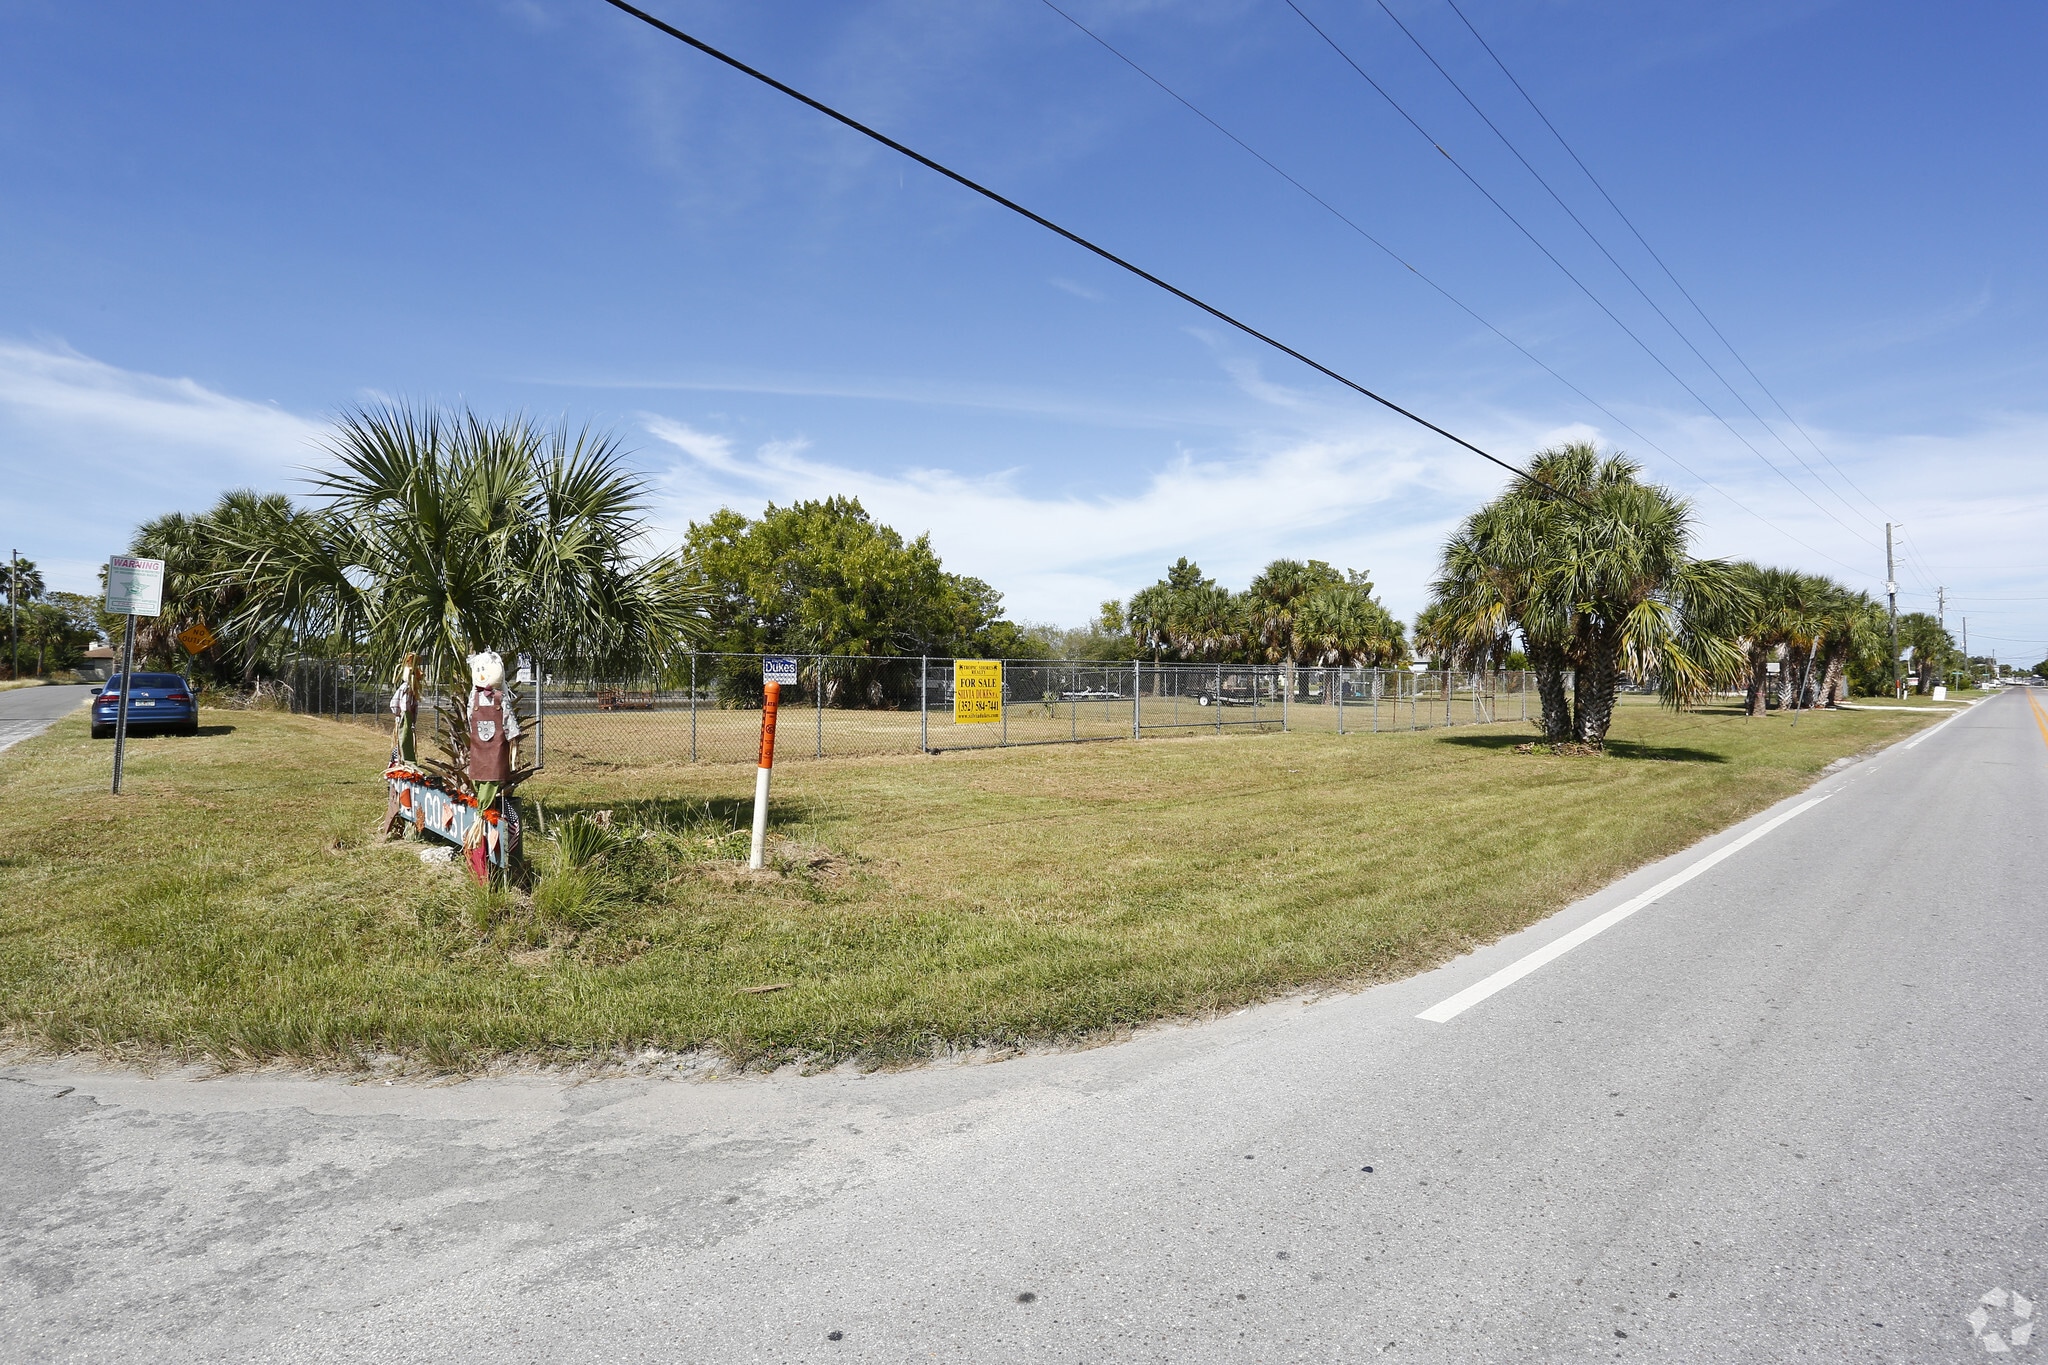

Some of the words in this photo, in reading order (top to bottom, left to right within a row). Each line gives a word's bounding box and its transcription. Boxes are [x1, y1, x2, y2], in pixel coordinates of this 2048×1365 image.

[114, 559, 159, 570] WARNING
[765, 661, 795, 672] Dukes
[960, 678, 976, 688] FOR
[978, 678, 996, 688] SALE
[958, 689, 975, 699] SILVIA
[976, 689, 992, 699] DUKES
[958, 700, 973, 712] (352)
